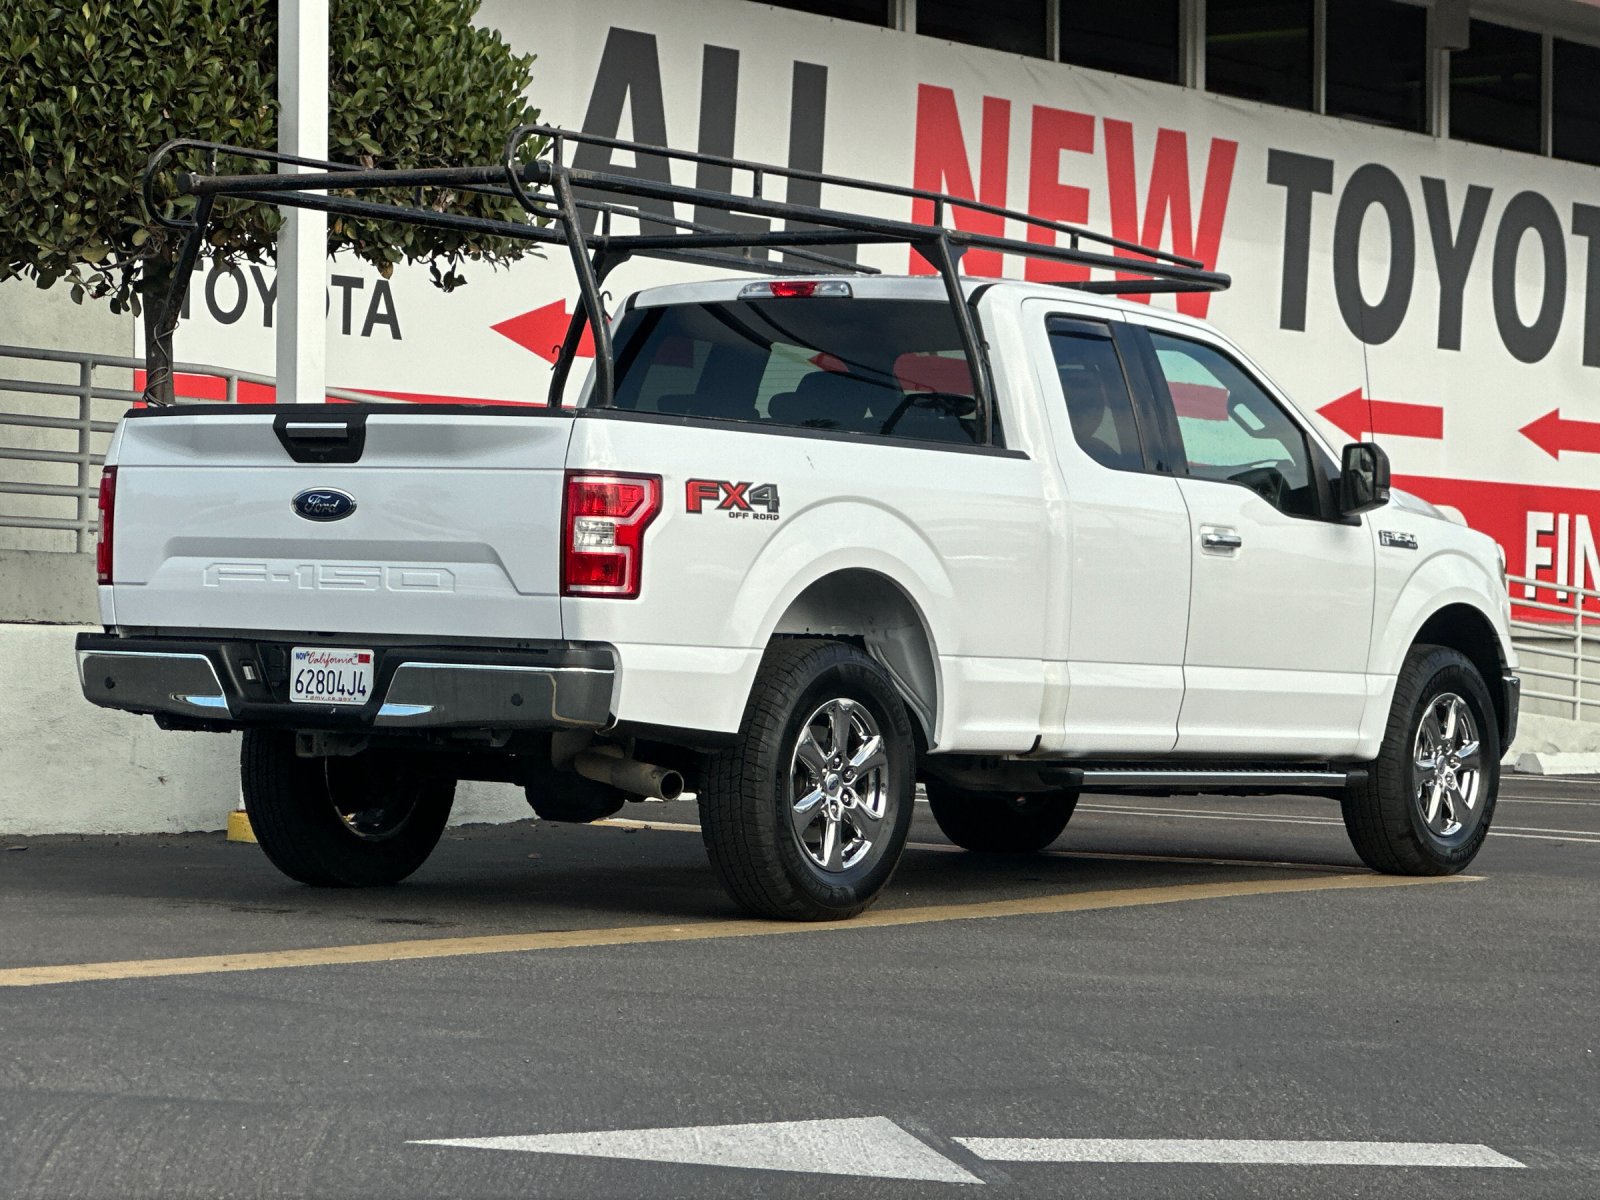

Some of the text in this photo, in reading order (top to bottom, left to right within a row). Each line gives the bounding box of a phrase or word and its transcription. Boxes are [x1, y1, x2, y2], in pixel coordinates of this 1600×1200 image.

[552, 26, 857, 276] ALL
[908, 82, 1239, 320] NEW
[304, 494, 341, 513] Ford
[685, 478, 780, 515] FX4
[728, 511, 780, 521] OFF ROAD
[203, 562, 456, 593] F-150
[307, 651, 358, 668] California
[295, 668, 367, 697] 62804J4
